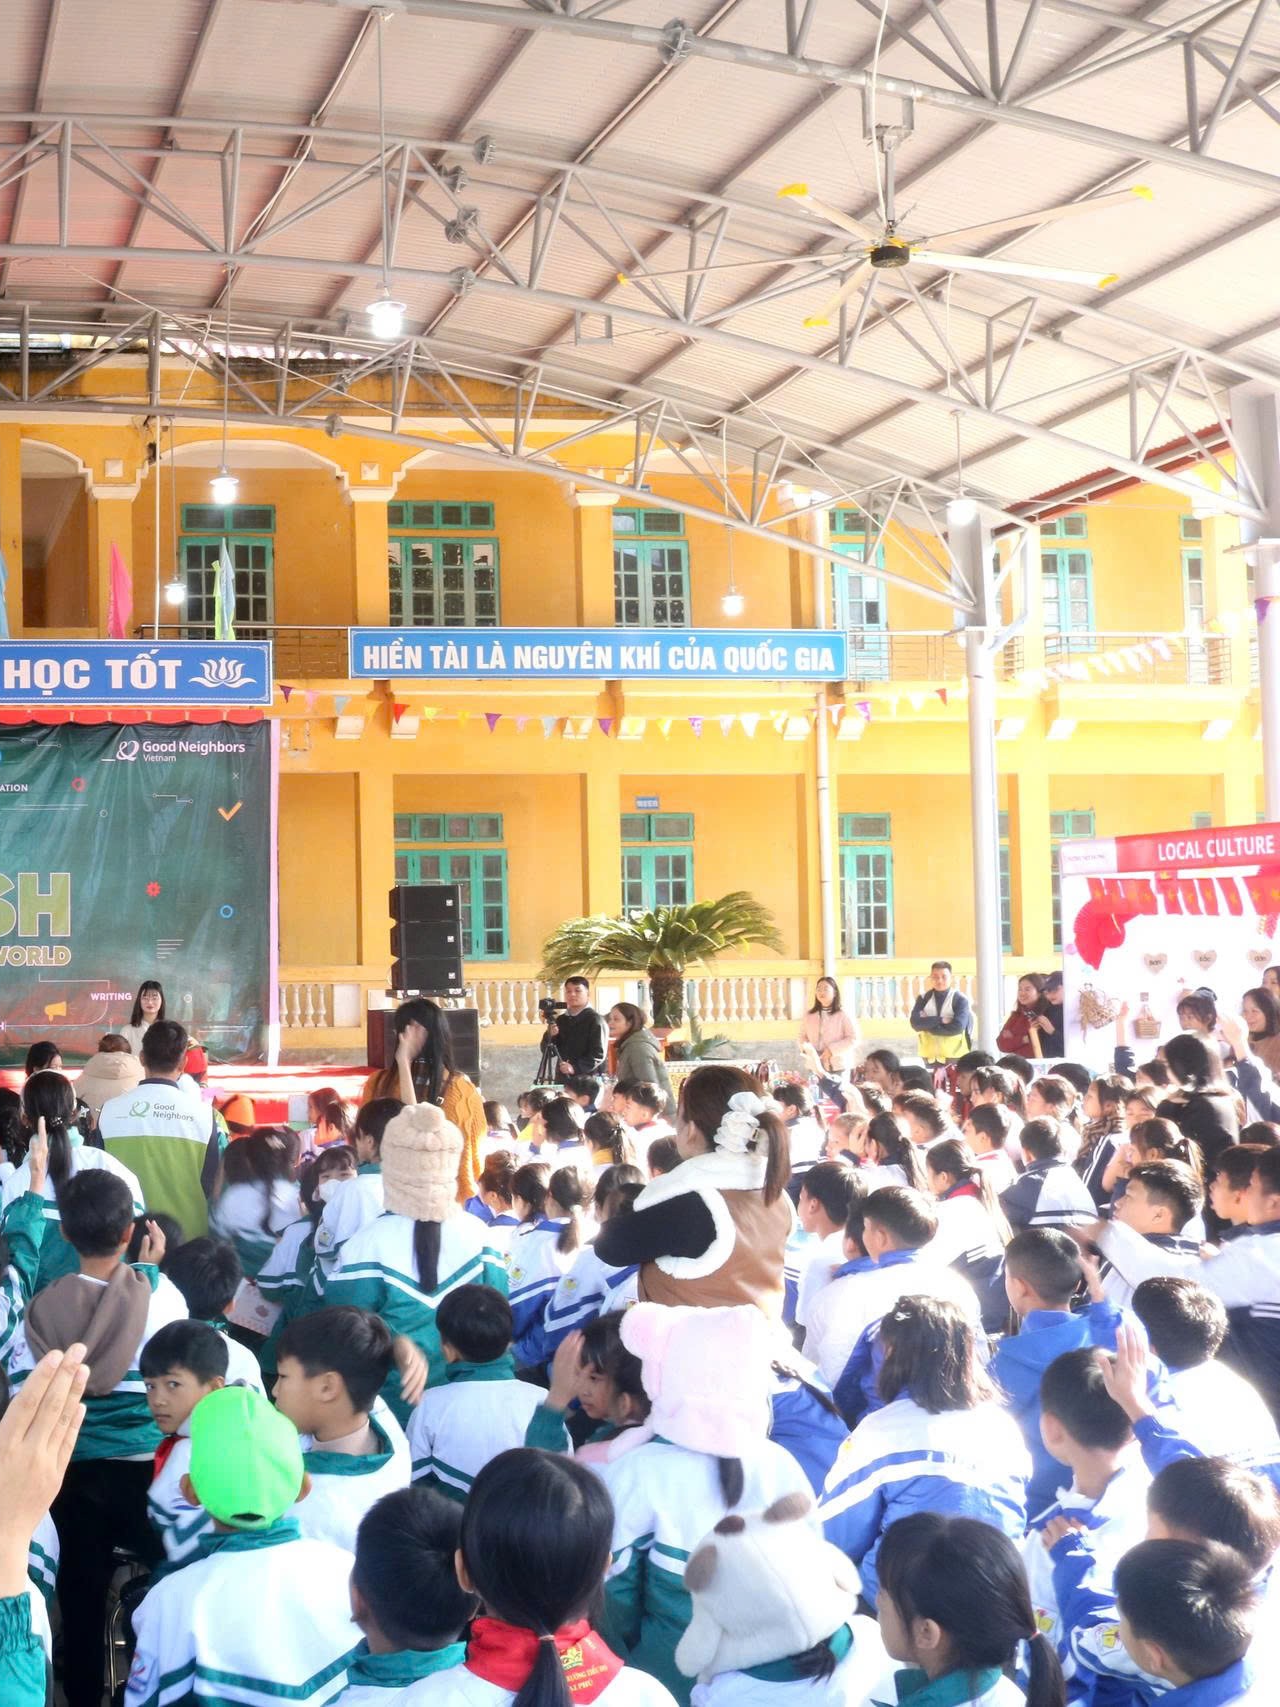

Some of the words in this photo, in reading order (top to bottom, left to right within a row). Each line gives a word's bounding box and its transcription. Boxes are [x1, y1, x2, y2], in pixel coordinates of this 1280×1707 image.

[363, 637, 422, 669] HIỀN
[430, 641, 468, 669] TÀI
[476, 641, 507, 669] LÀ
[514, 641, 612, 669] NGUYÊN
[621, 641, 661, 669] KHÍ
[668, 637, 717, 670] CỦA
[724, 638, 787, 672] QUỐC
[795, 647, 835, 671] GIA
[3, 659, 91, 695] HỌC
[105, 649, 182, 689] TỐT
[142, 741, 176, 753] Good
[179, 741, 246, 756] Neighbors
[143, 754, 176, 762] Vietnam
[1158, 842, 1204, 861] LOCAL
[1206, 835, 1275, 857] CULTURE
[91, 993, 132, 1001] WRITING
[154, 1103, 175, 1111] Good
[153, 1111, 194, 1121] Neighbors
